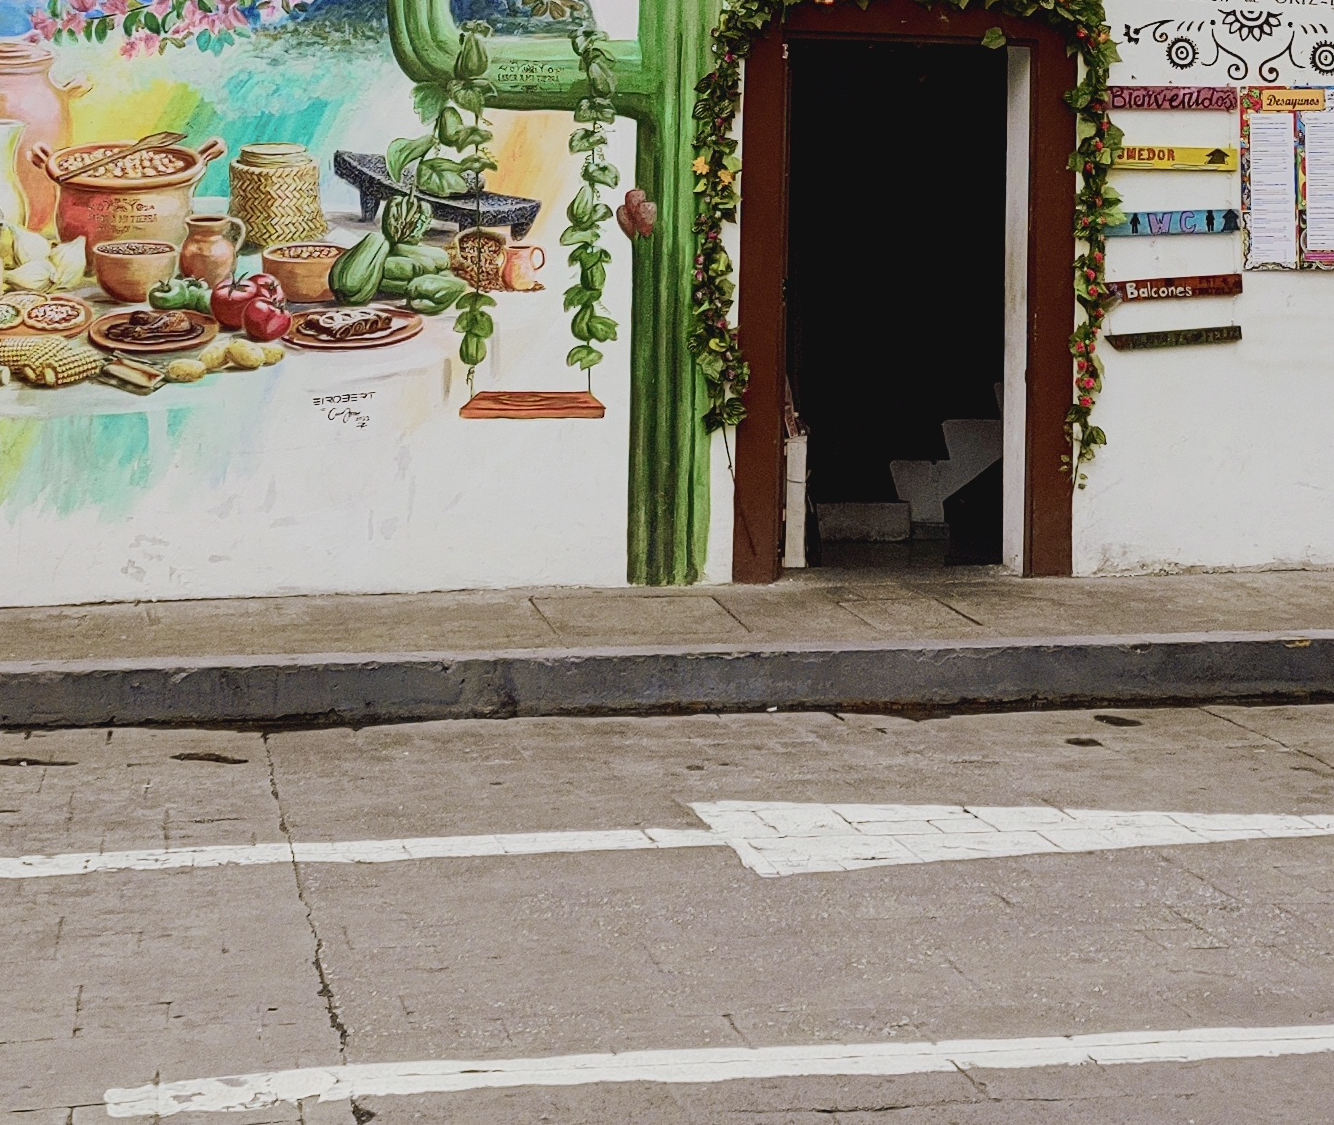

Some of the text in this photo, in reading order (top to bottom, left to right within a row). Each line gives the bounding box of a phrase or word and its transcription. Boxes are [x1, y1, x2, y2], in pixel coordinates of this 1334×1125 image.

[1267, 94, 1320, 110] Desayunos
[1117, 147, 1176, 162] OMEDOR
[1125, 281, 1193, 299] Balcones
